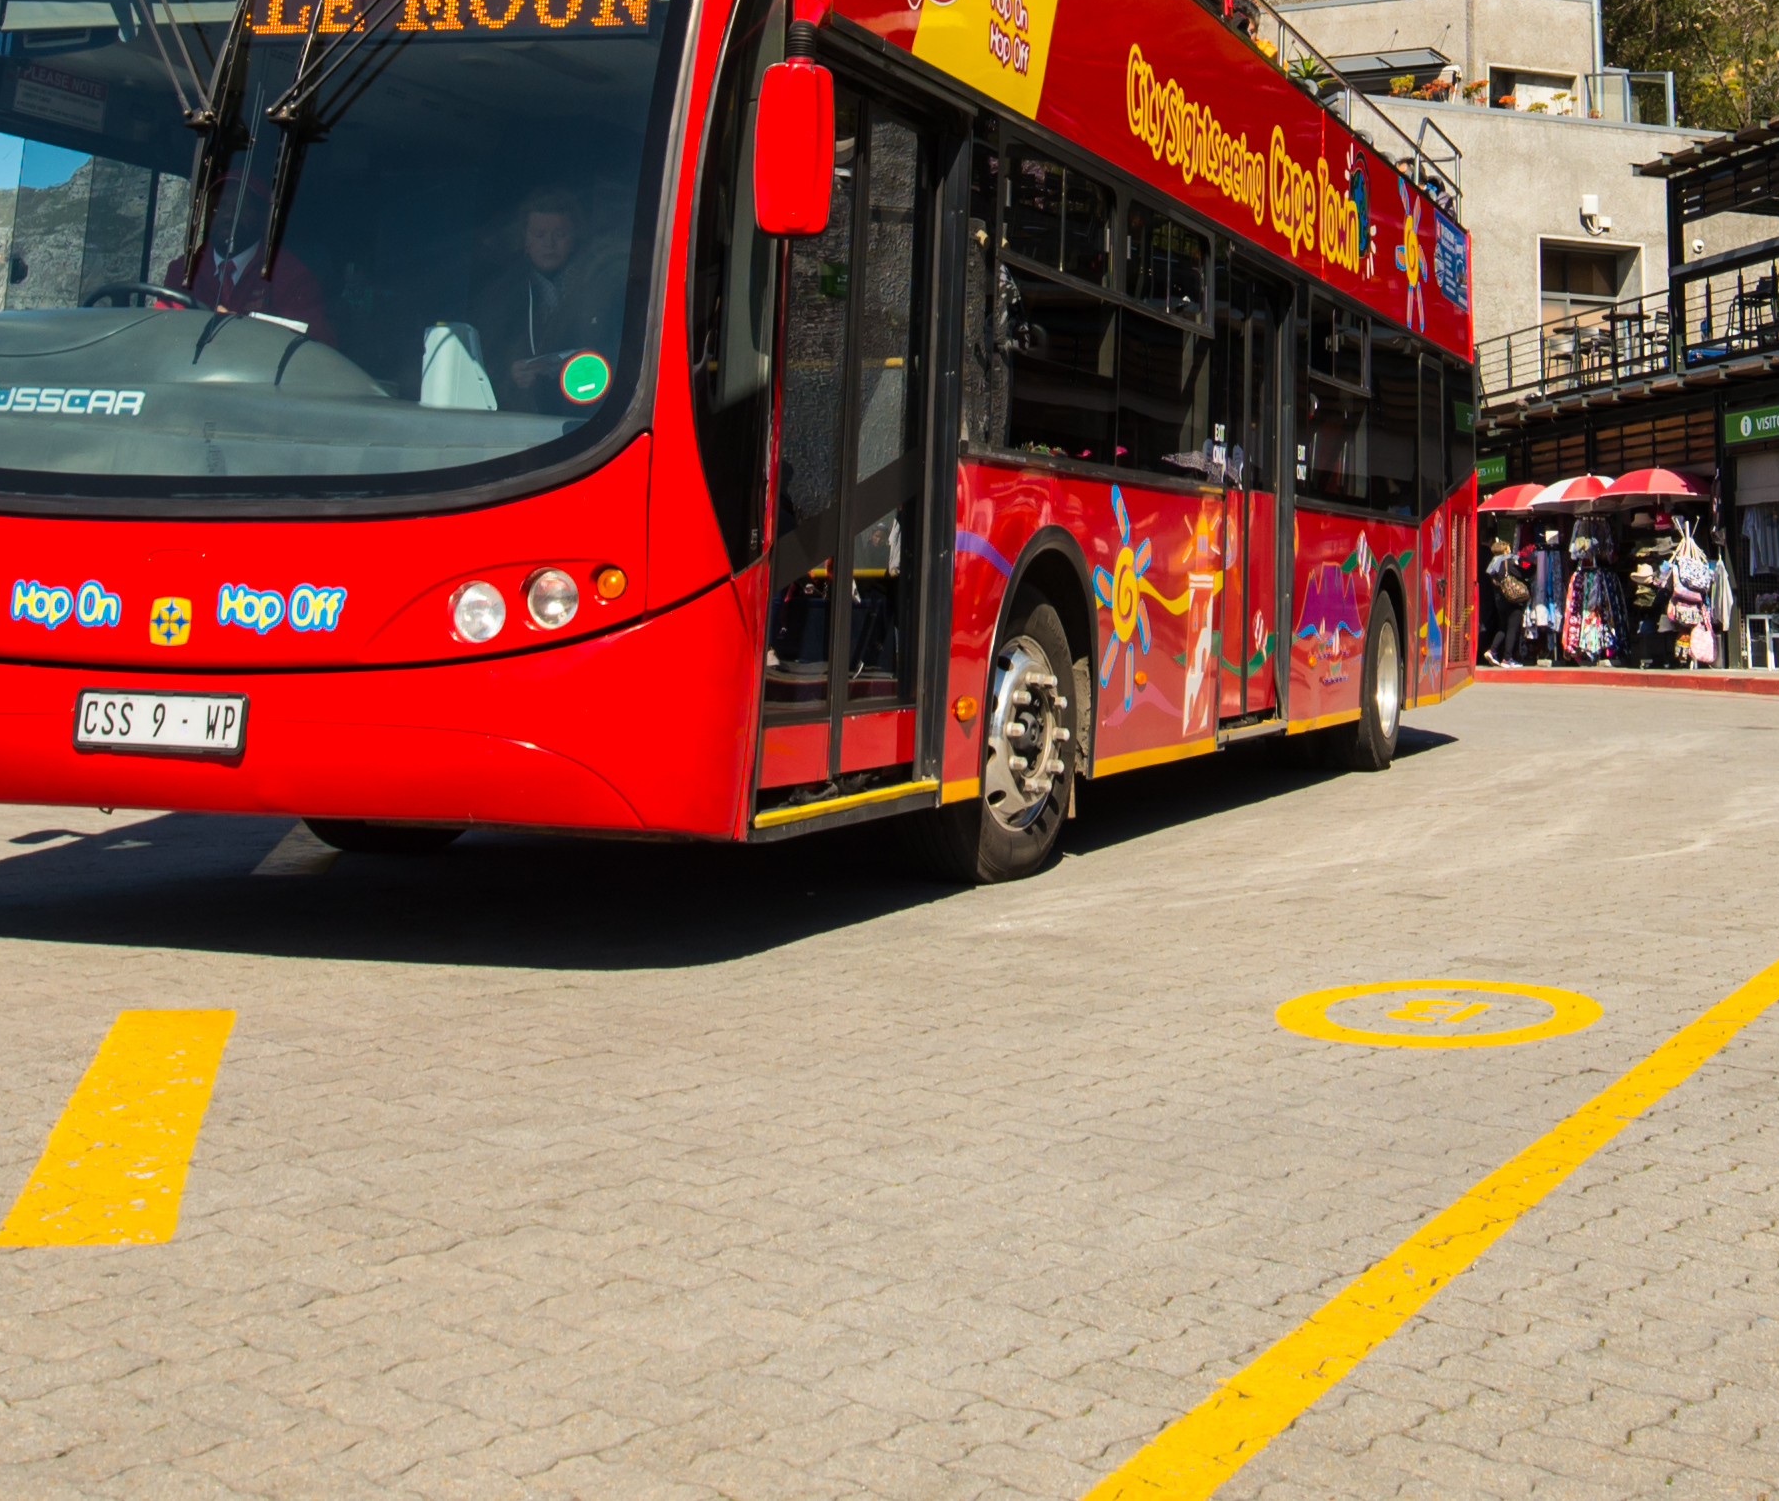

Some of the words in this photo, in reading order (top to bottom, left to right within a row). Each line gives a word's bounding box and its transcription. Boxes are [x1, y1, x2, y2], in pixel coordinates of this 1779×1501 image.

[989, 18, 1011, 69] Hop
[1013, 32, 1030, 77] Off
[23, 65, 70, 89] PLEASE
[71, 77, 103, 99] NOTE
[1126, 43, 1265, 226] CitySightseeing
[1269, 125, 1316, 258] Cape
[1317, 156, 1360, 274] Town
[11, 579, 72, 630] Hop
[74, 581, 122, 628] On
[217, 583, 285, 634] Hop
[288, 582, 347, 632] Off
[84, 700, 134, 736] CSS
[152, 703, 166, 738] 9
[205, 705, 236, 741] WP
